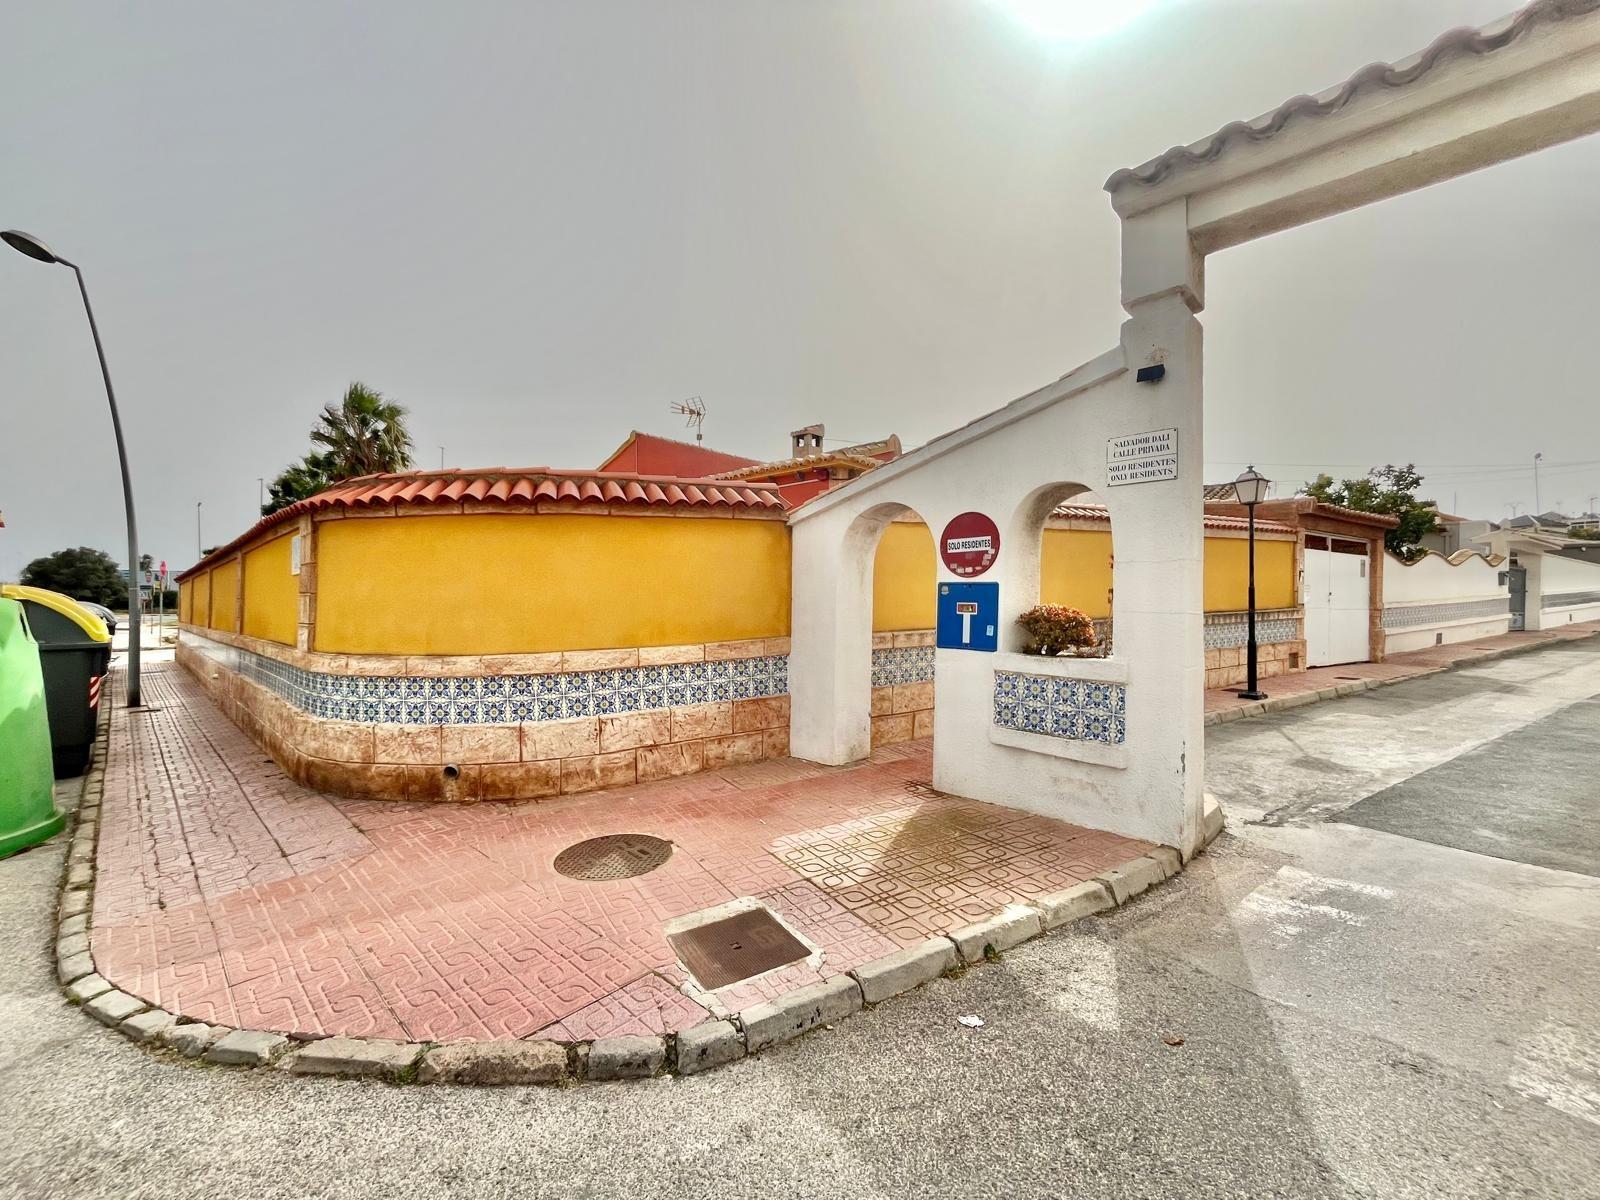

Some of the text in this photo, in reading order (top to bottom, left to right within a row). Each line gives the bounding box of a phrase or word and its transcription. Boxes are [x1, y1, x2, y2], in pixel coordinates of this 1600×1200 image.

[1114, 434, 1170, 448] SALVADOR DALI
[1113, 443, 1170, 458] CALLE PRIVADA
[1128, 458, 1176, 470] RESIDENTES
[1130, 468, 1172, 479] RESIDENTS
[948, 539, 991, 550] SOLO RESIDENTES
